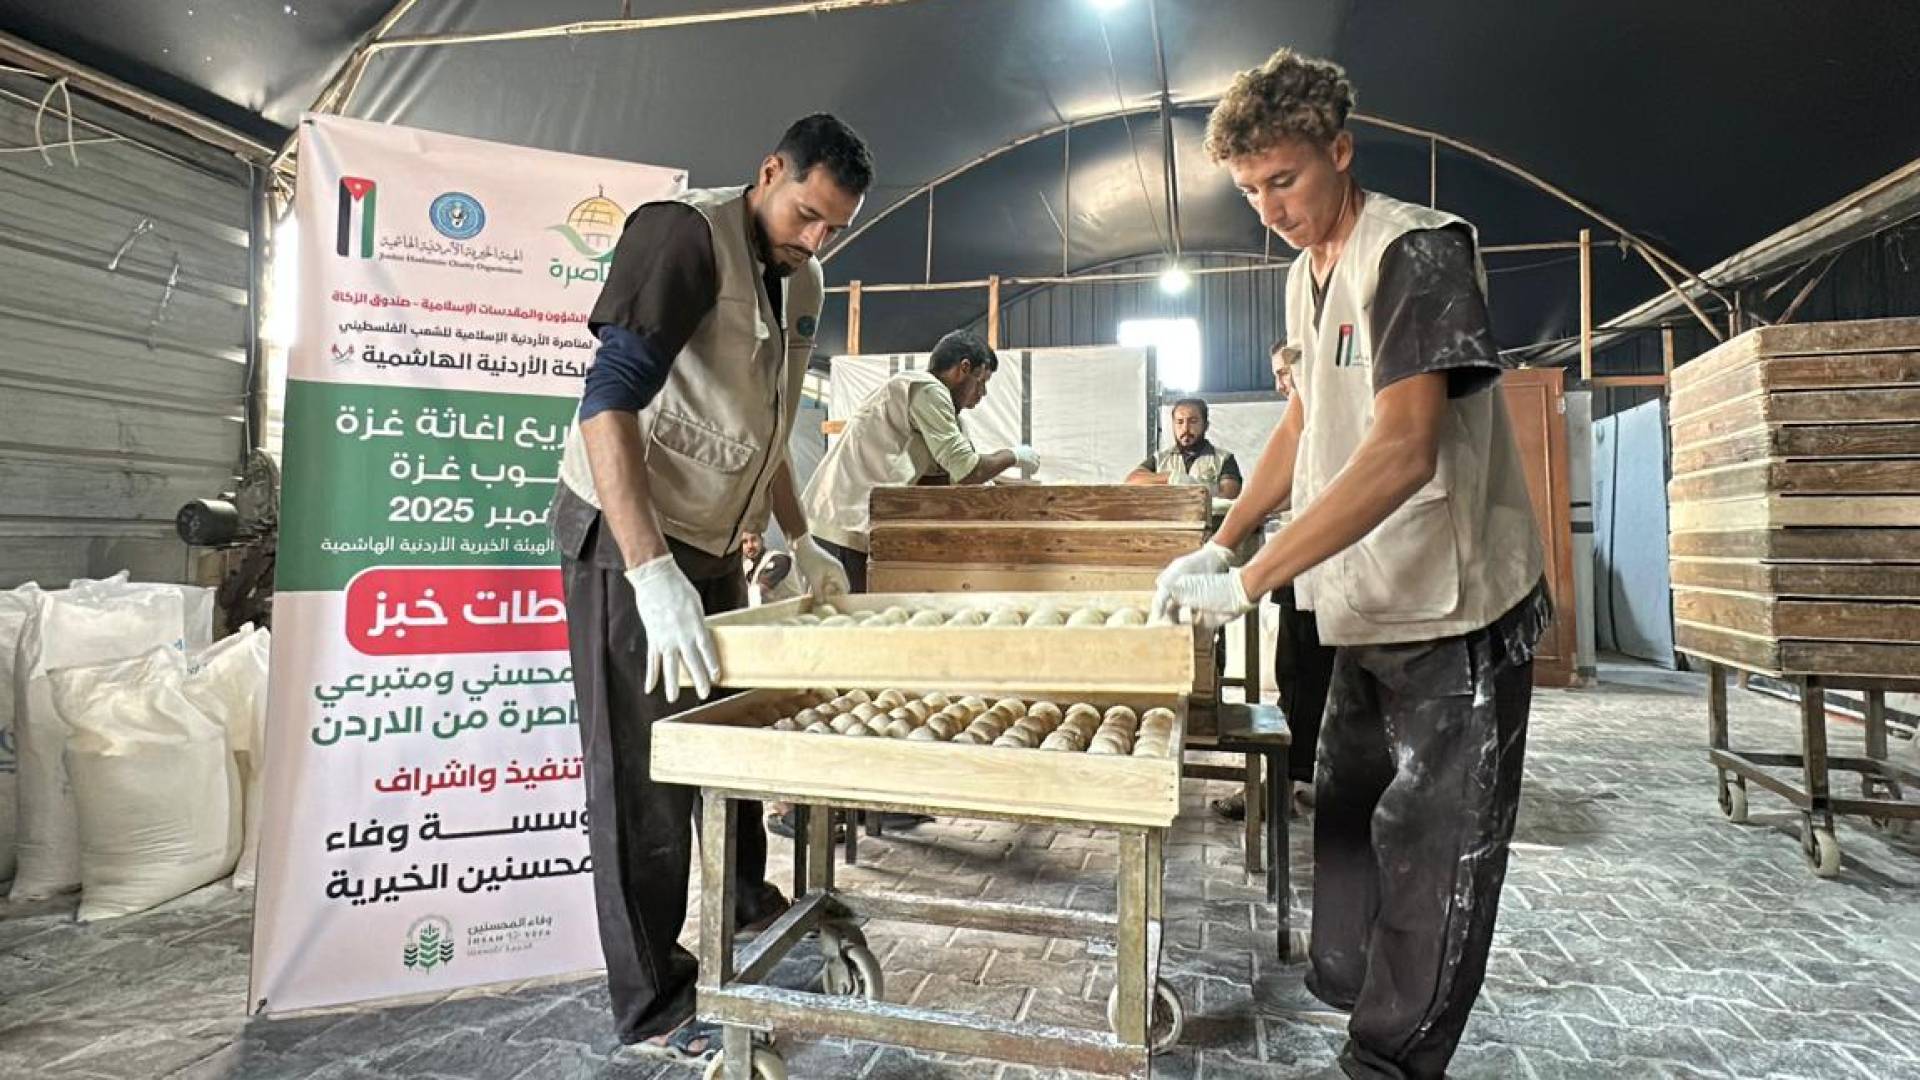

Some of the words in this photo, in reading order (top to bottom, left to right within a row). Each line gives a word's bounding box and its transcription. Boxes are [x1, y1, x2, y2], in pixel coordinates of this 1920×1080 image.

[332, 289, 368, 305] الزكاة
[369, 293, 411, 308] صندوق
[421, 298, 477, 316] الإسلامية
[479, 304, 544, 322] والمقدسات
[545, 311, 587, 324] الشؤون
[339, 319, 407, 335] الفلسطيني
[411, 325, 452, 339] للشعب
[455, 327, 508, 345] الإسلامية
[511, 332, 550, 349] الأردنية
[552, 336, 593, 350] لمناصرة
[362, 344, 472, 370] الهاشمية
[477, 354, 547, 378] الأردنية
[336, 405, 404, 441] غزة
[416, 407, 505, 441] اغاثة
[515, 416, 568, 450] ريع
[390, 452, 461, 485] غزة
[388, 496, 474, 522] 2025
[320, 535, 395, 555] الهاشمية
[400, 535, 455, 553] الأردنية
[460, 537, 509, 555] الخيرية
[514, 537, 555, 555] الهيئة
[367, 588, 448, 638] خبز
[463, 589, 567, 625] طات
[314, 666, 454, 709] ومتبرعي
[312, 706, 423, 746] الاردن
[432, 709, 488, 739] من
[374, 760, 497, 796] واشراف
[505, 757, 585, 790] تنفيذ
[326, 818, 409, 853] وفاء
[326, 863, 448, 906] الخيرية
[457, 854, 593, 894] محسنين
